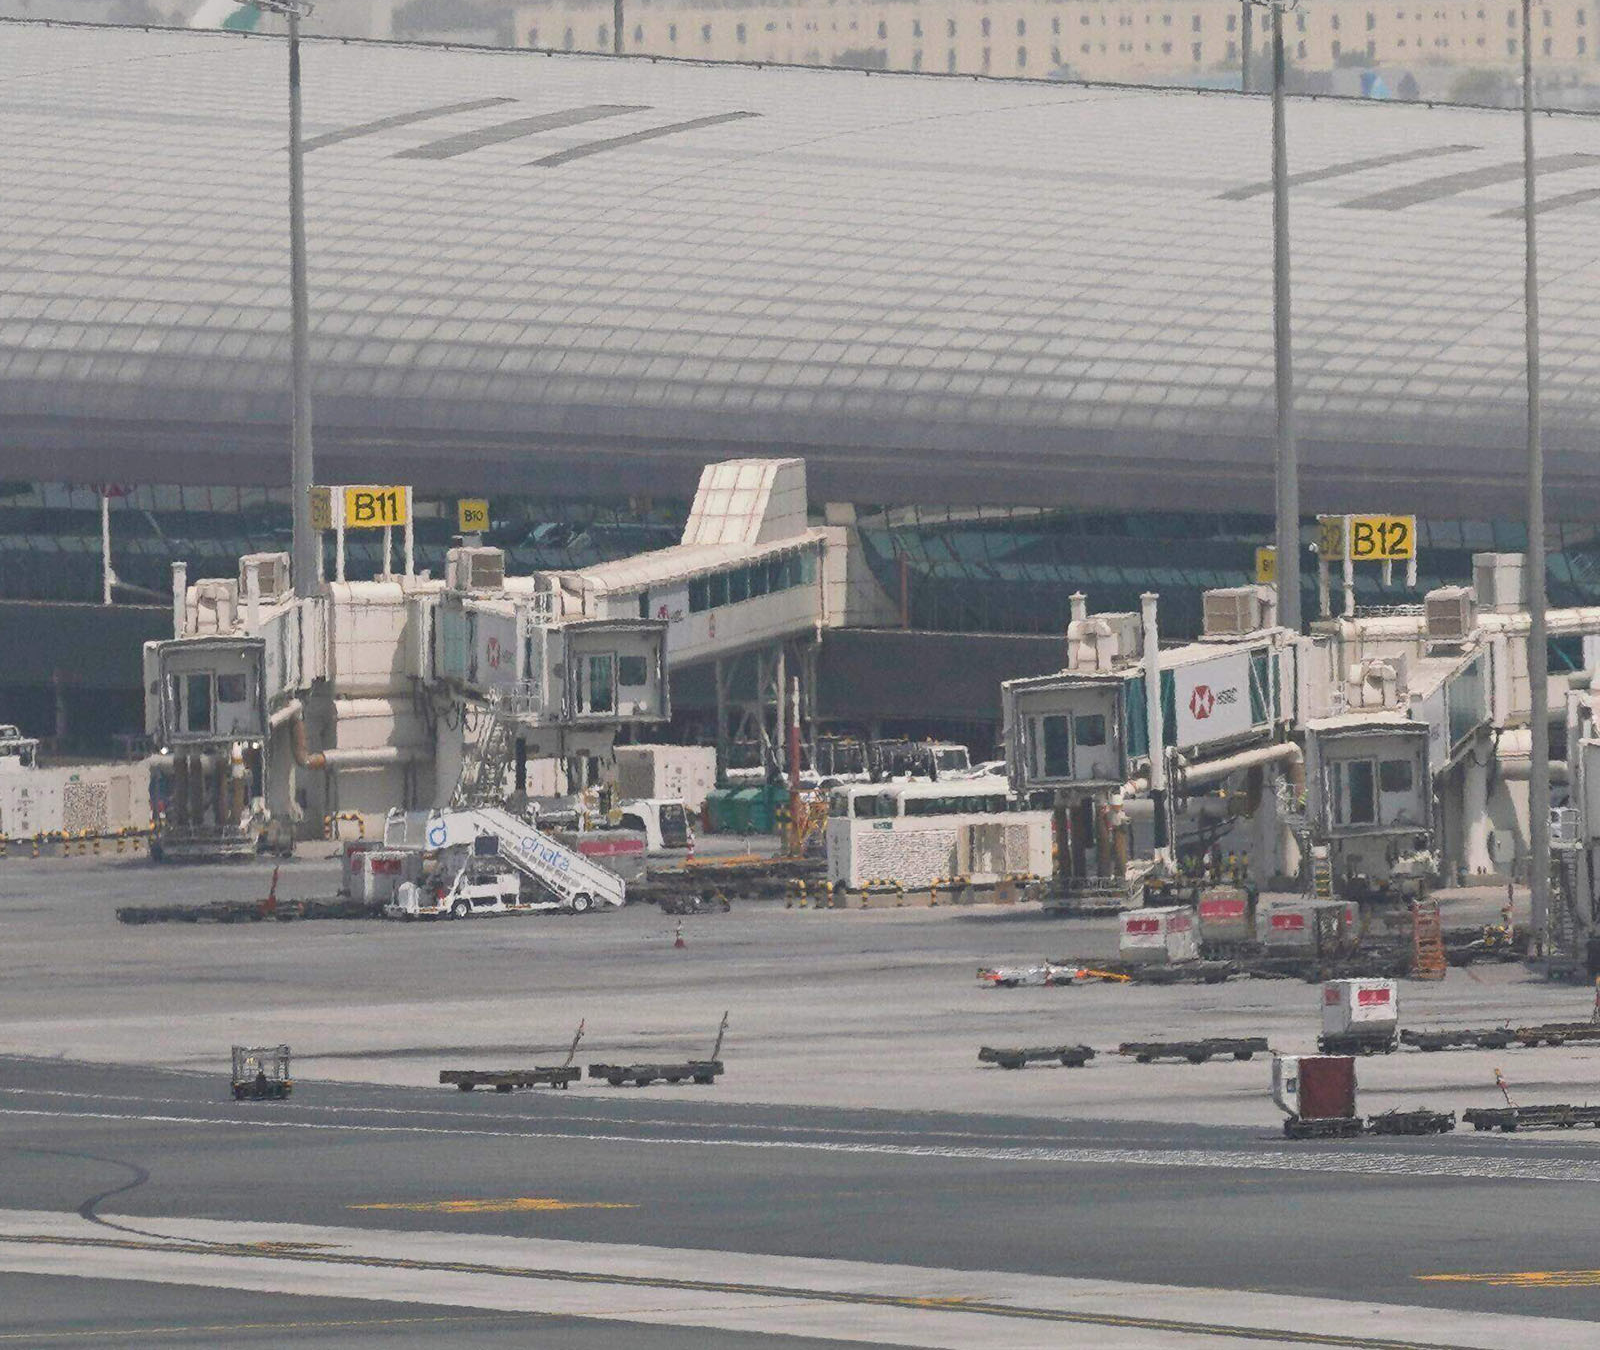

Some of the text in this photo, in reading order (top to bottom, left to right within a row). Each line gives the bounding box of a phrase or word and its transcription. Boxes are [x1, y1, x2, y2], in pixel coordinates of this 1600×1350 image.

[354, 492, 398, 522] B11
[463, 509, 484, 523] B10
[1353, 521, 1409, 557] B12
[520, 835, 571, 872] dnata
